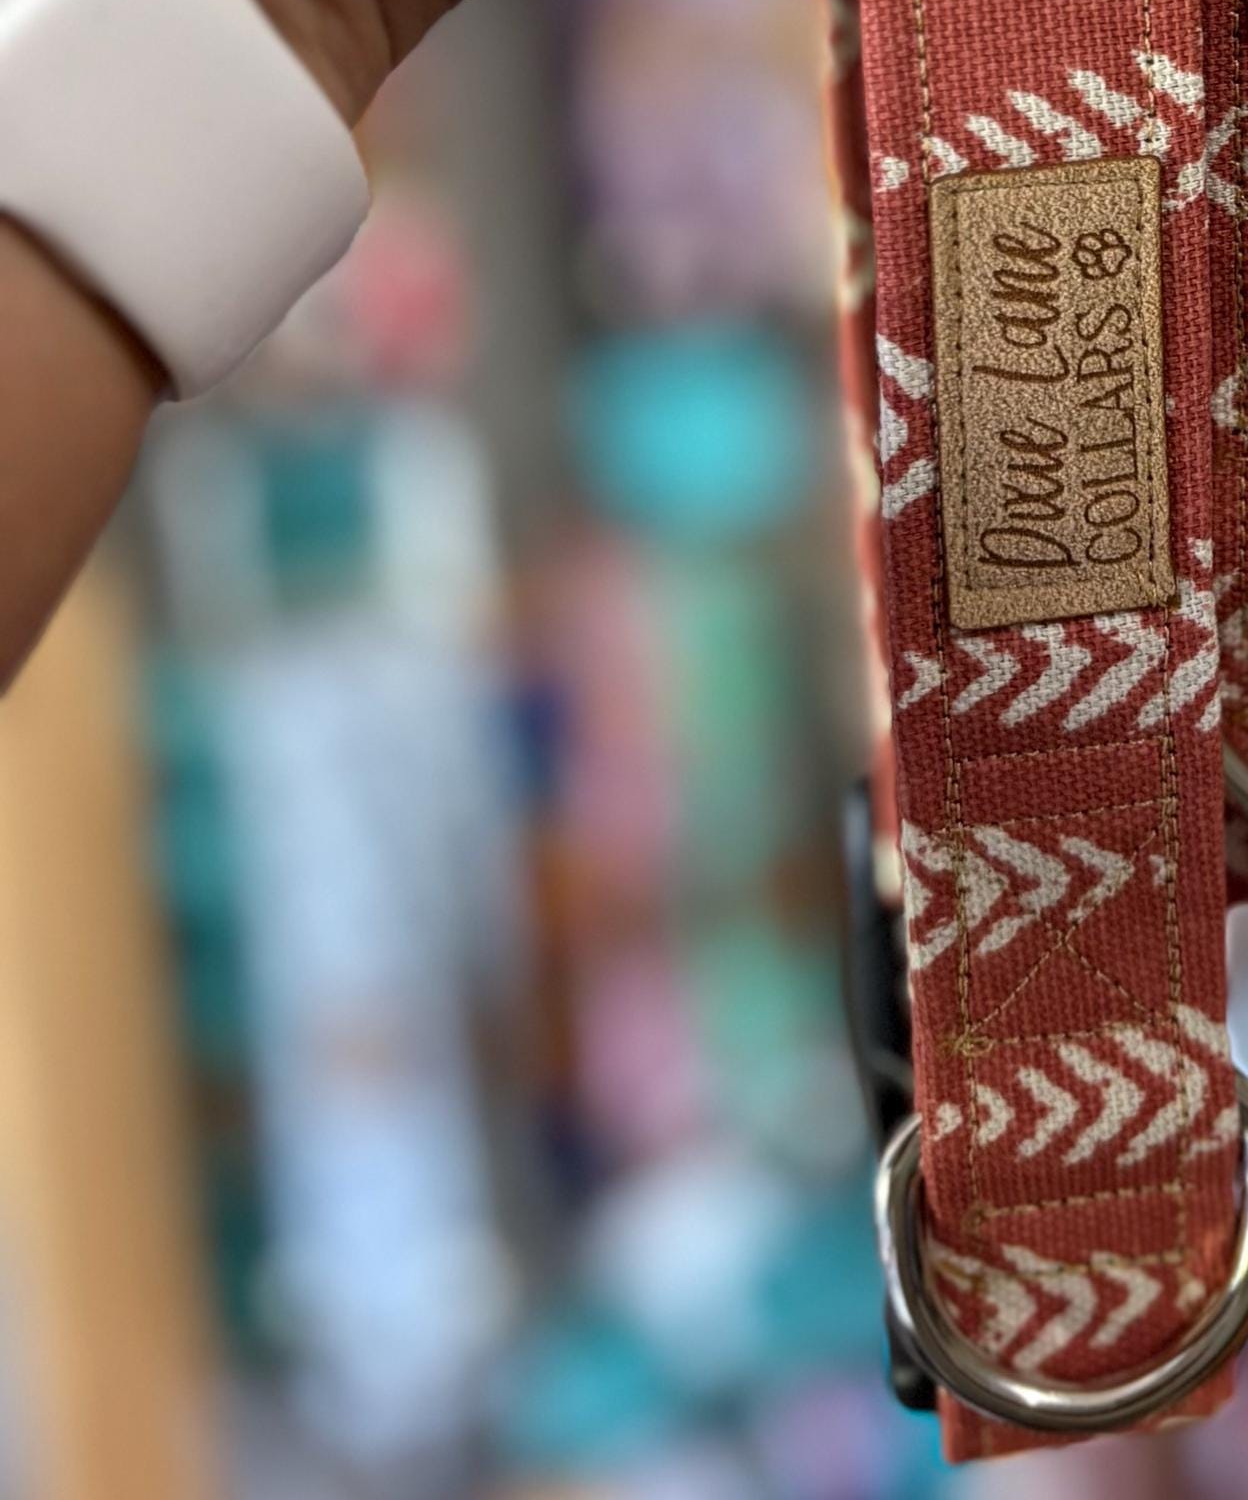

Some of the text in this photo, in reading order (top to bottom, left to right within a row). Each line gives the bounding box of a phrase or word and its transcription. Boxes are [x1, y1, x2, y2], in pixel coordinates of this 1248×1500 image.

[972, 221, 1081, 567] Dixie Lane
[1075, 304, 1142, 565] COLLARS
